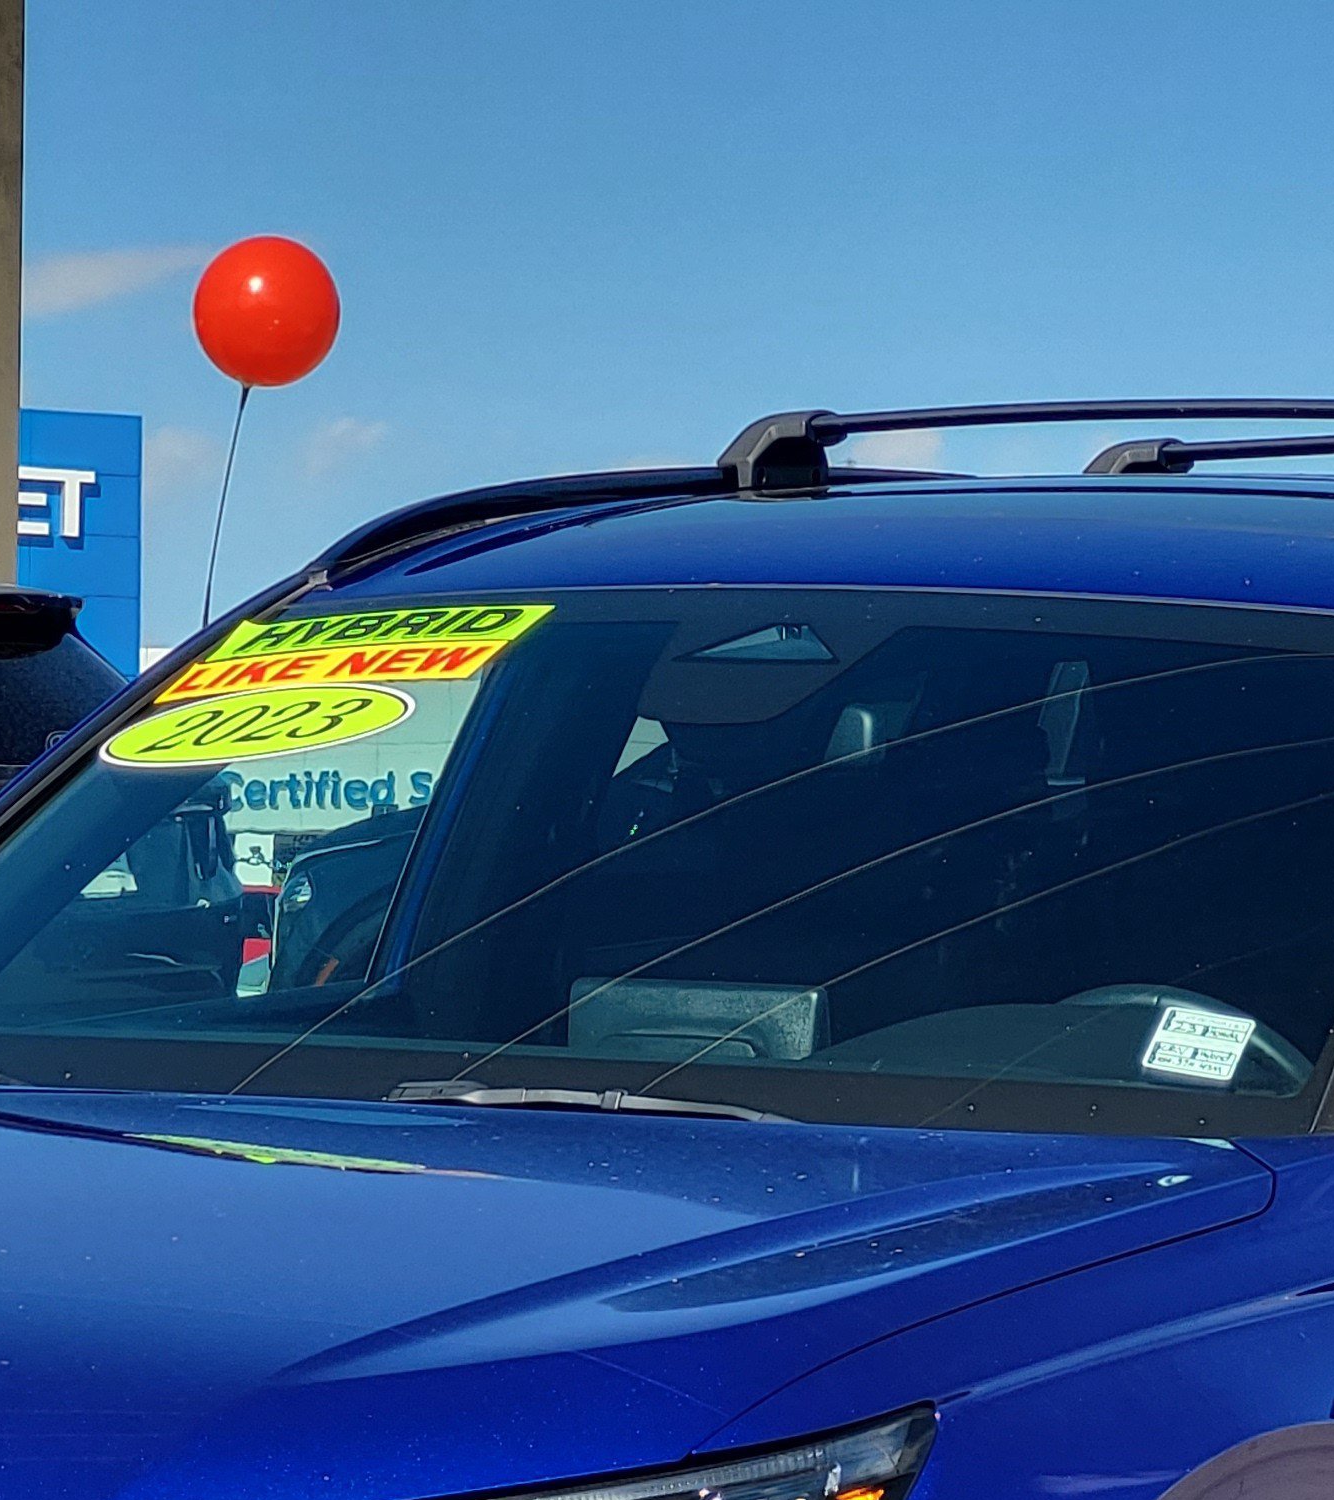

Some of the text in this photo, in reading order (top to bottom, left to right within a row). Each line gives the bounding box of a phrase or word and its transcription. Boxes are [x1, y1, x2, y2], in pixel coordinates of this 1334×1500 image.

[238, 608, 525, 654] HYBRID
[177, 645, 491, 692] LIKE NEW
[136, 698, 373, 753] 2023
